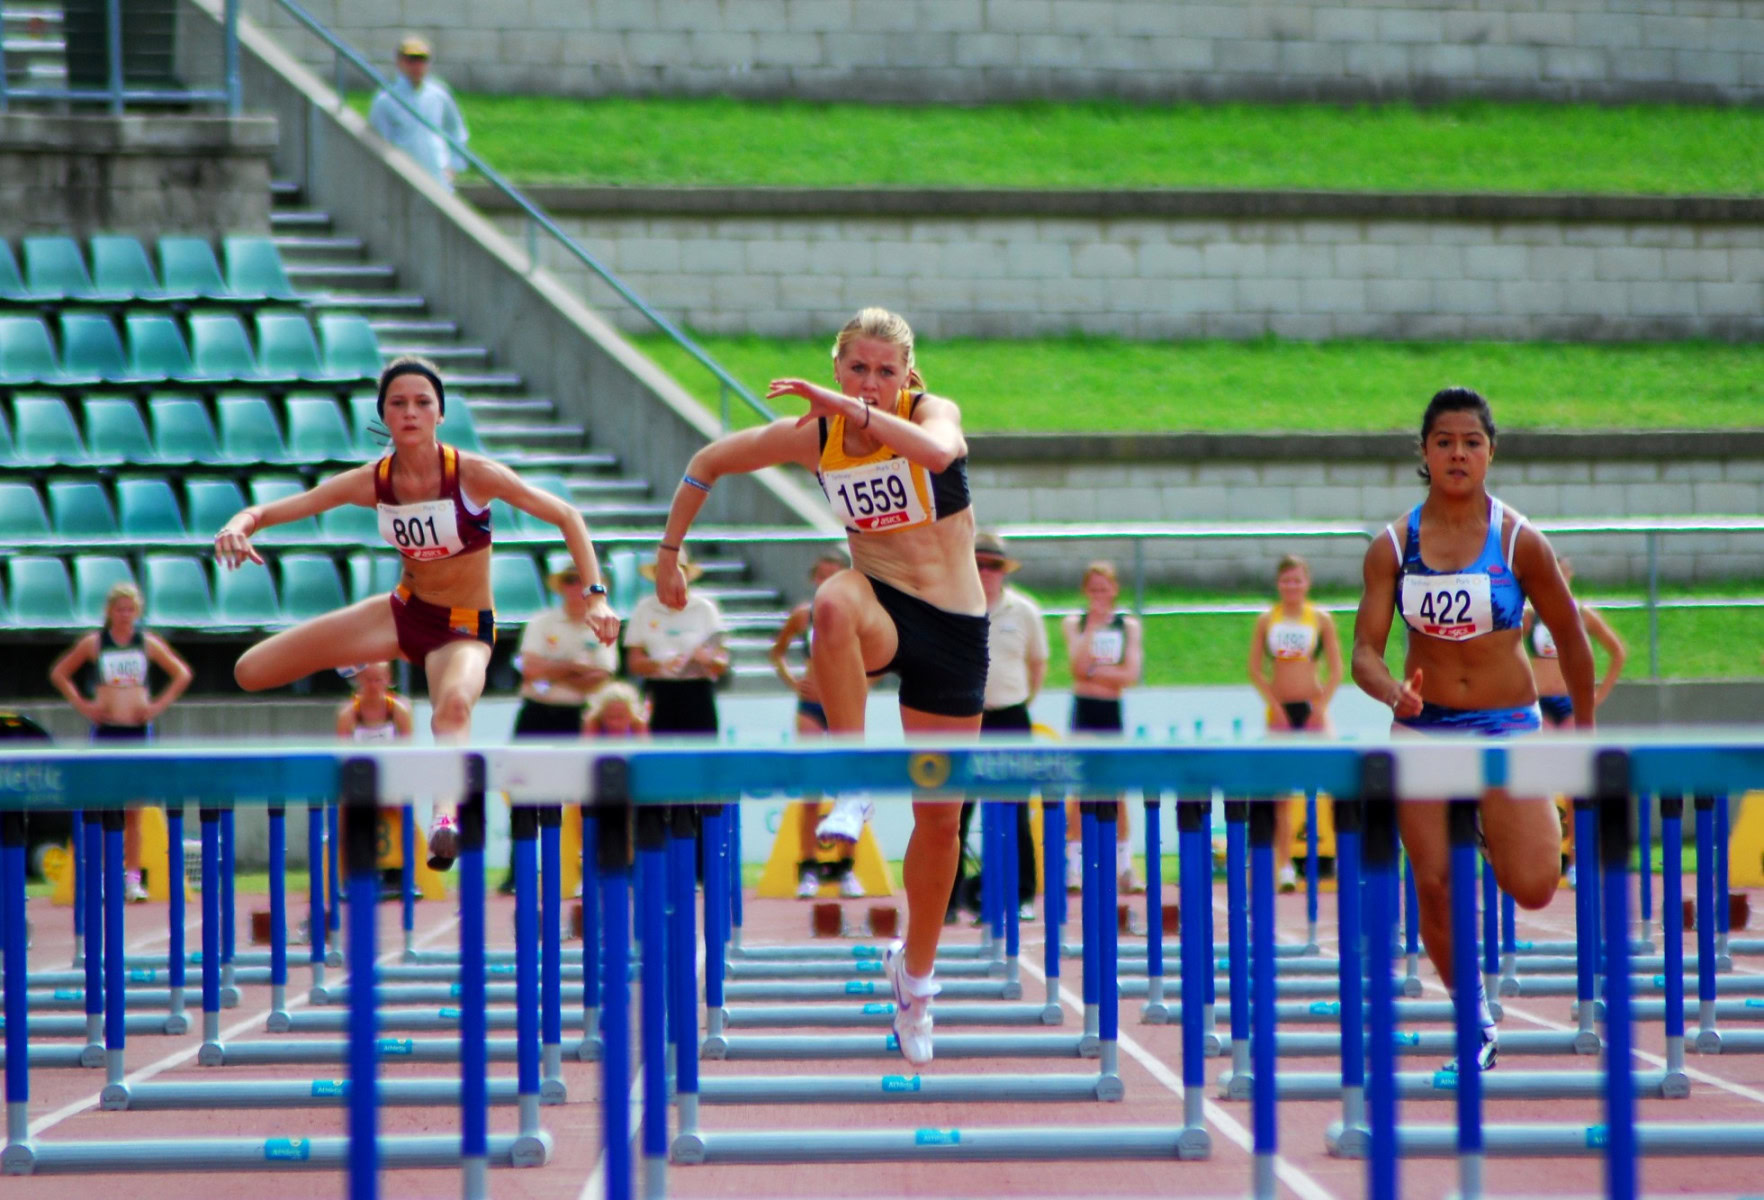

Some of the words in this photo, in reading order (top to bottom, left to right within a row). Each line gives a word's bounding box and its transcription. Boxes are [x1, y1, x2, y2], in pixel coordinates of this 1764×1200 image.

[838, 475, 907, 517] 1559
[393, 516, 439, 547] 801
[1420, 590, 1473, 624] 422
